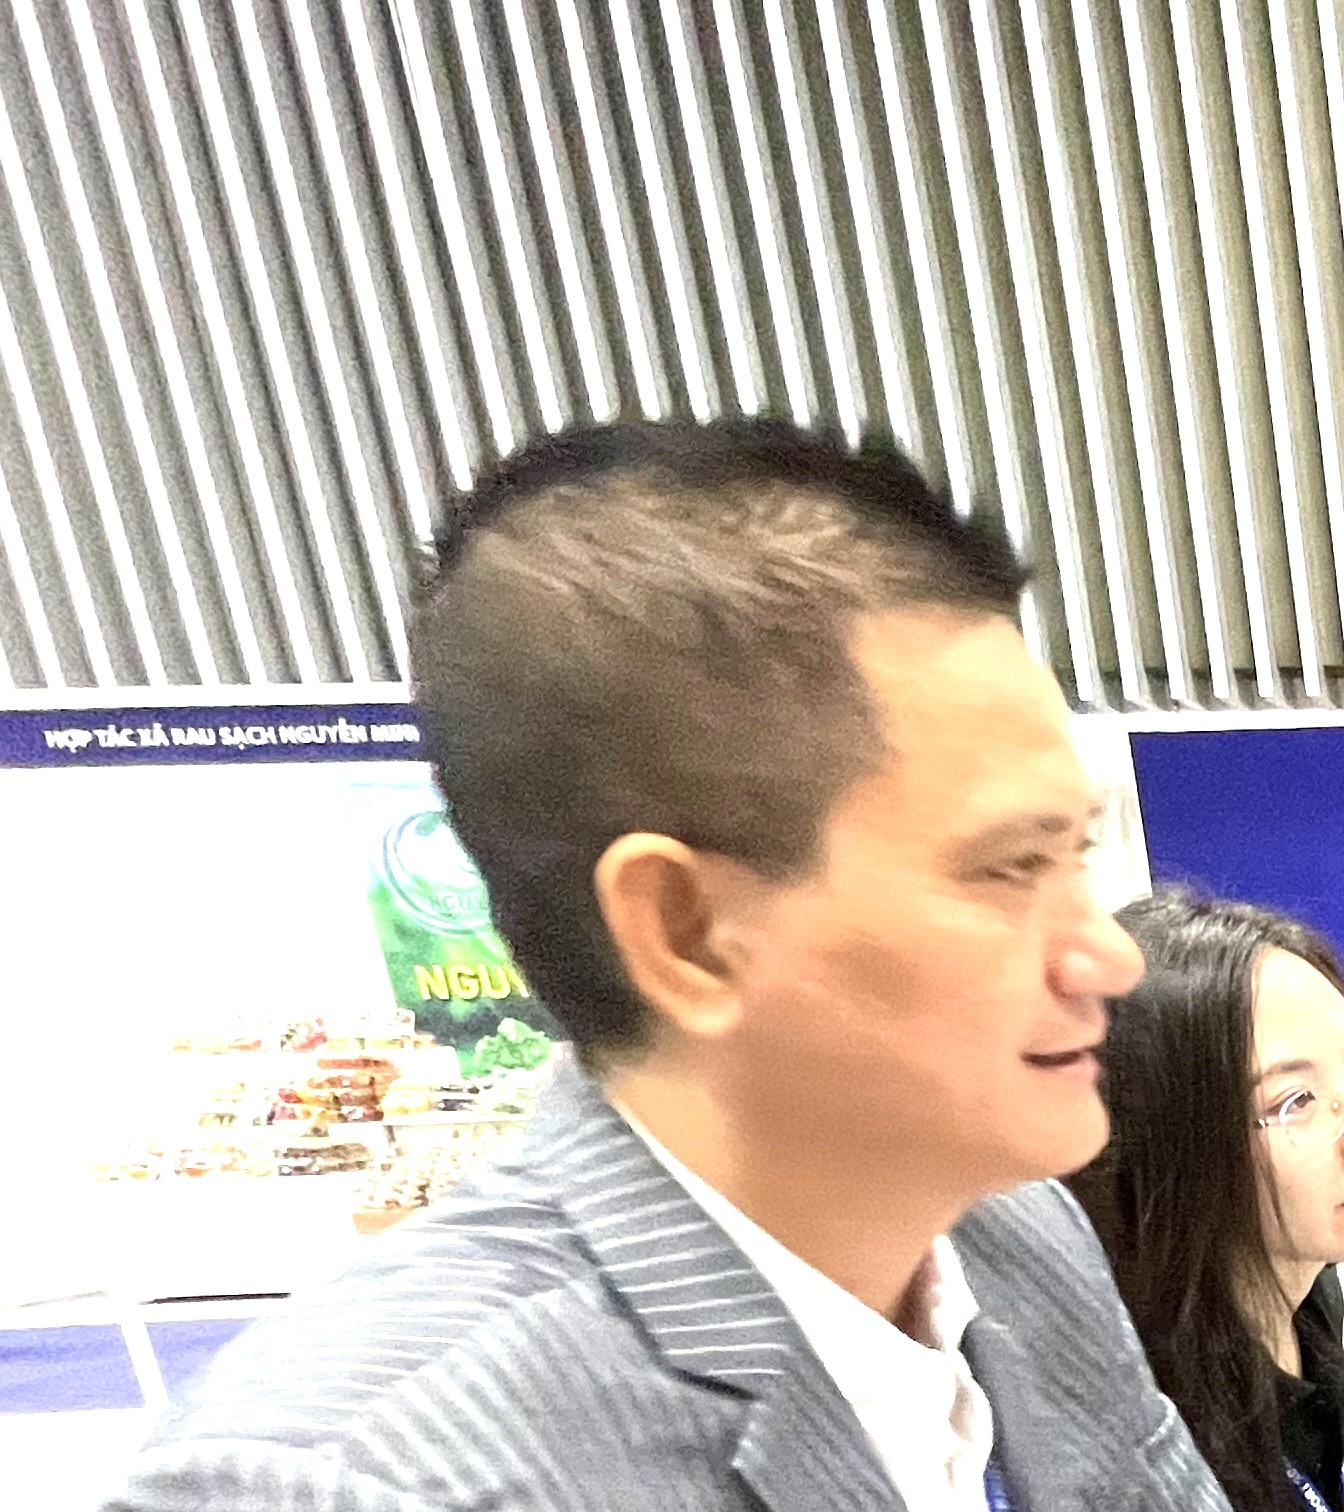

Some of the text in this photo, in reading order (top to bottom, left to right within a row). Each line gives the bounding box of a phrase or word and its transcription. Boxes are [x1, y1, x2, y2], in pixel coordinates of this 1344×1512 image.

[95, 725, 136, 748] TÁC
[171, 727, 216, 746] RAU
[218, 725, 277, 750] SẠCH
